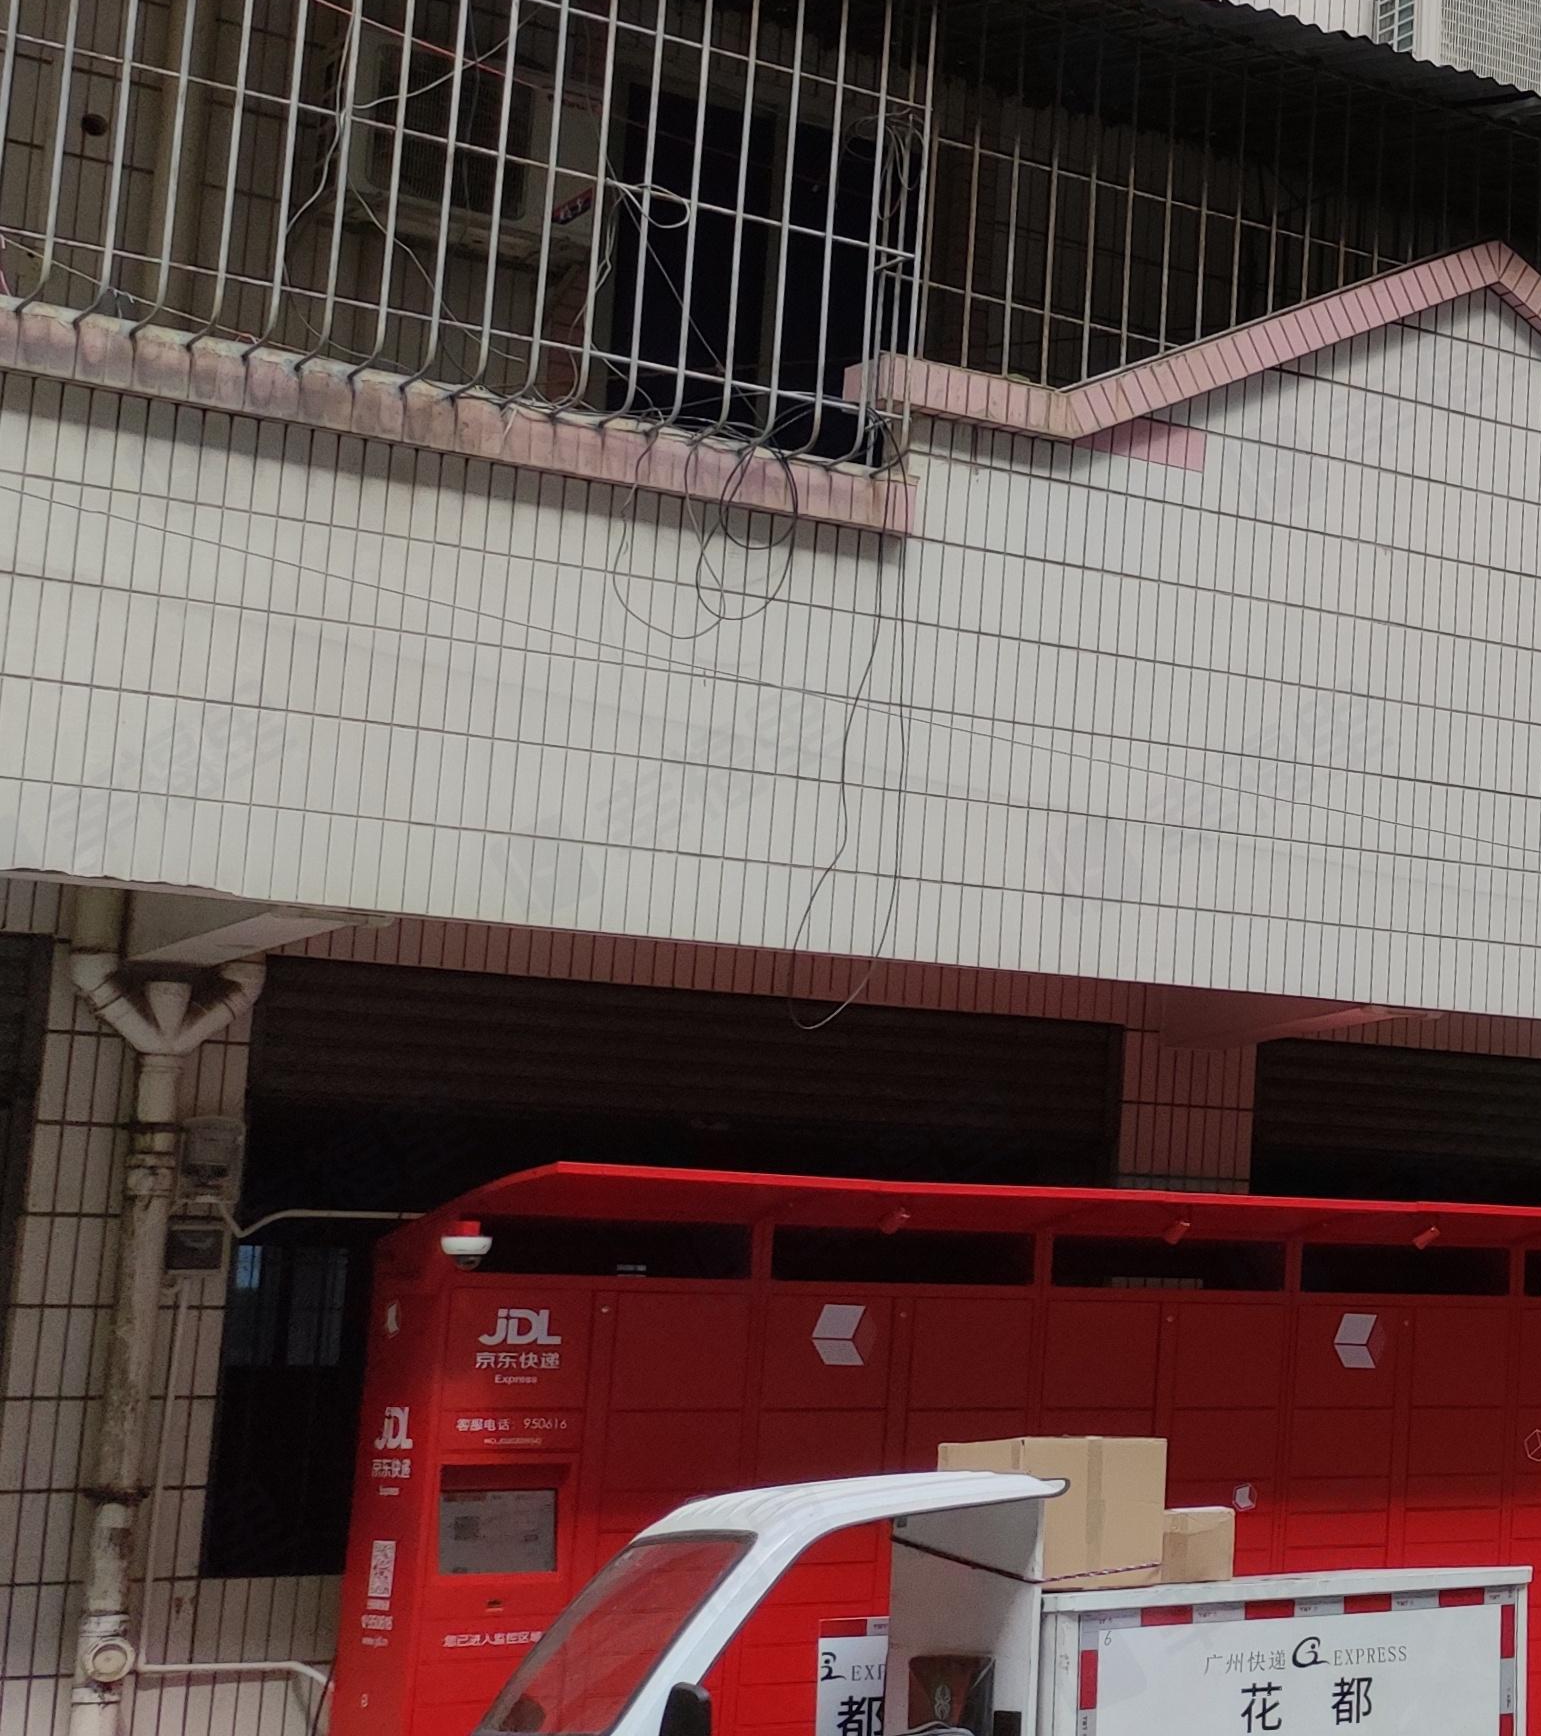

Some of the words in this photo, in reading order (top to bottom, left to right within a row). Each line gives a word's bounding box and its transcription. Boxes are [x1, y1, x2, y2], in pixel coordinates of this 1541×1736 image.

[479, 1308, 561, 1345] JDL
[475, 1352, 560, 1369] 京东快递
[494, 1374, 538, 1384] Express
[523, 1419, 568, 1431] 950616
[371, 1458, 411, 1479] 京东快递
[1203, 1649, 1287, 1676] 广州快递
[1334, 1645, 1408, 1667] EXPRESS
